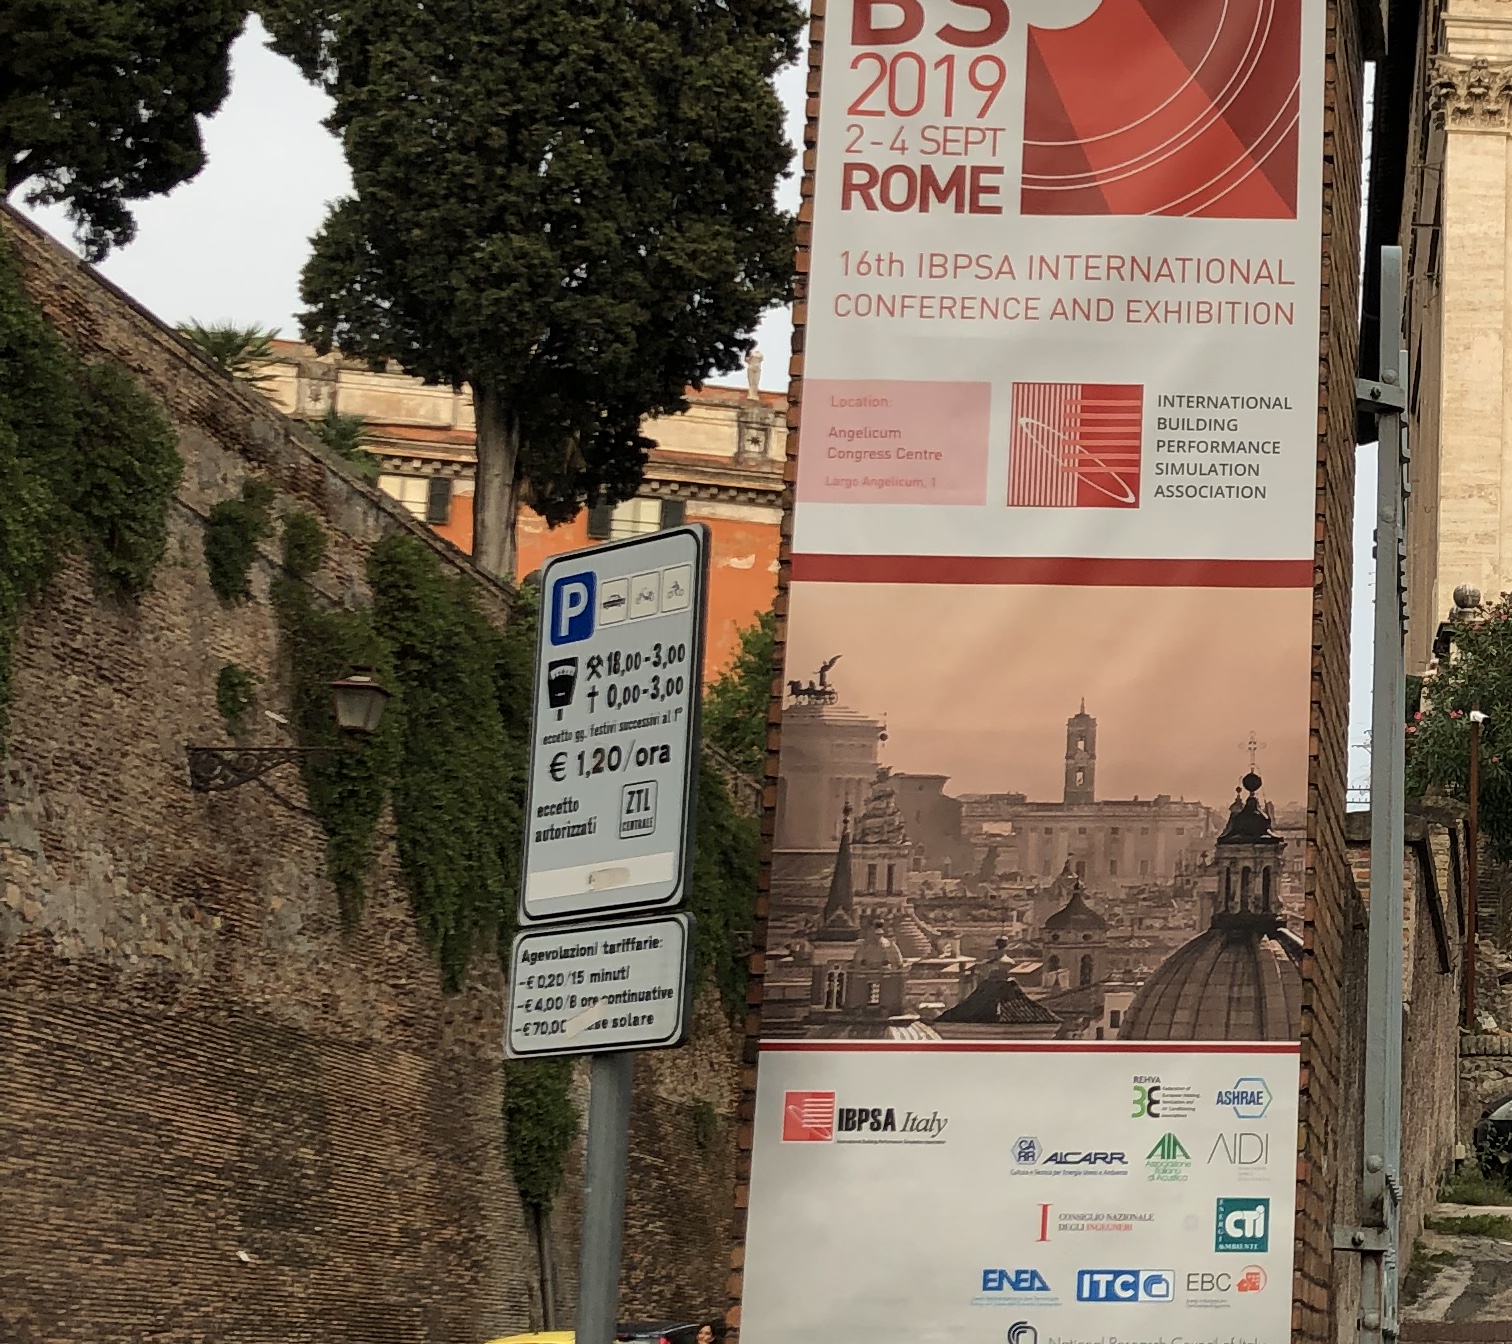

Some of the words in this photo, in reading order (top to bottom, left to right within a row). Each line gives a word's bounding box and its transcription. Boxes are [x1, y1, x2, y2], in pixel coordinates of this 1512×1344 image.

[847, 51, 1007, 119] 2019
[919, 124, 1006, 157] SEPT
[841, 162, 1005, 215] ROME
[839, 250, 905, 278] 16th
[917, 252, 1016, 281] IBPSA
[1028, 254, 1296, 285] INTERNATIONAL
[833, 293, 1040, 321] CONFERENCE
[1049, 297, 1114, 323] AND
[1125, 299, 1295, 326] EXHIBITION
[1158, 394, 1293, 410] INTERNATIONAL
[828, 426, 902, 442] Angelicum
[1157, 417, 1239, 431] BUILDING
[827, 447, 892, 462] Congress
[896, 447, 943, 461] Centre
[1156, 439, 1281, 454] PERFORMANCE
[1154, 462, 1260, 476] SIMULATION
[825, 476, 859, 489] Largo
[1154, 484, 1267, 499] ASSOCIATION
[559, 582, 588, 637] P
[542, 729, 573, 745] eccetto
[590, 720, 617, 737] festivi
[618, 711, 660, 732] successivi
[662, 709, 671, 724] al
[537, 796, 580, 818] eccetto
[625, 788, 651, 814] ZTL
[535, 816, 598, 843] autorizzati
[622, 817, 654, 832] CENTRALE
[521, 941, 599, 966] Agevolazioni
[589, 965, 631, 984] minuti
[611, 1012, 655, 1029] solare
[1215, 1090, 1264, 1106] ASHRAE
[837, 1107, 897, 1132] IBPSA
[900, 1110, 949, 1138] Italy
[982, 1268, 1052, 1292] ENEA
[1082, 1273, 1136, 1299] ITC
[1187, 1272, 1232, 1292] EBC
